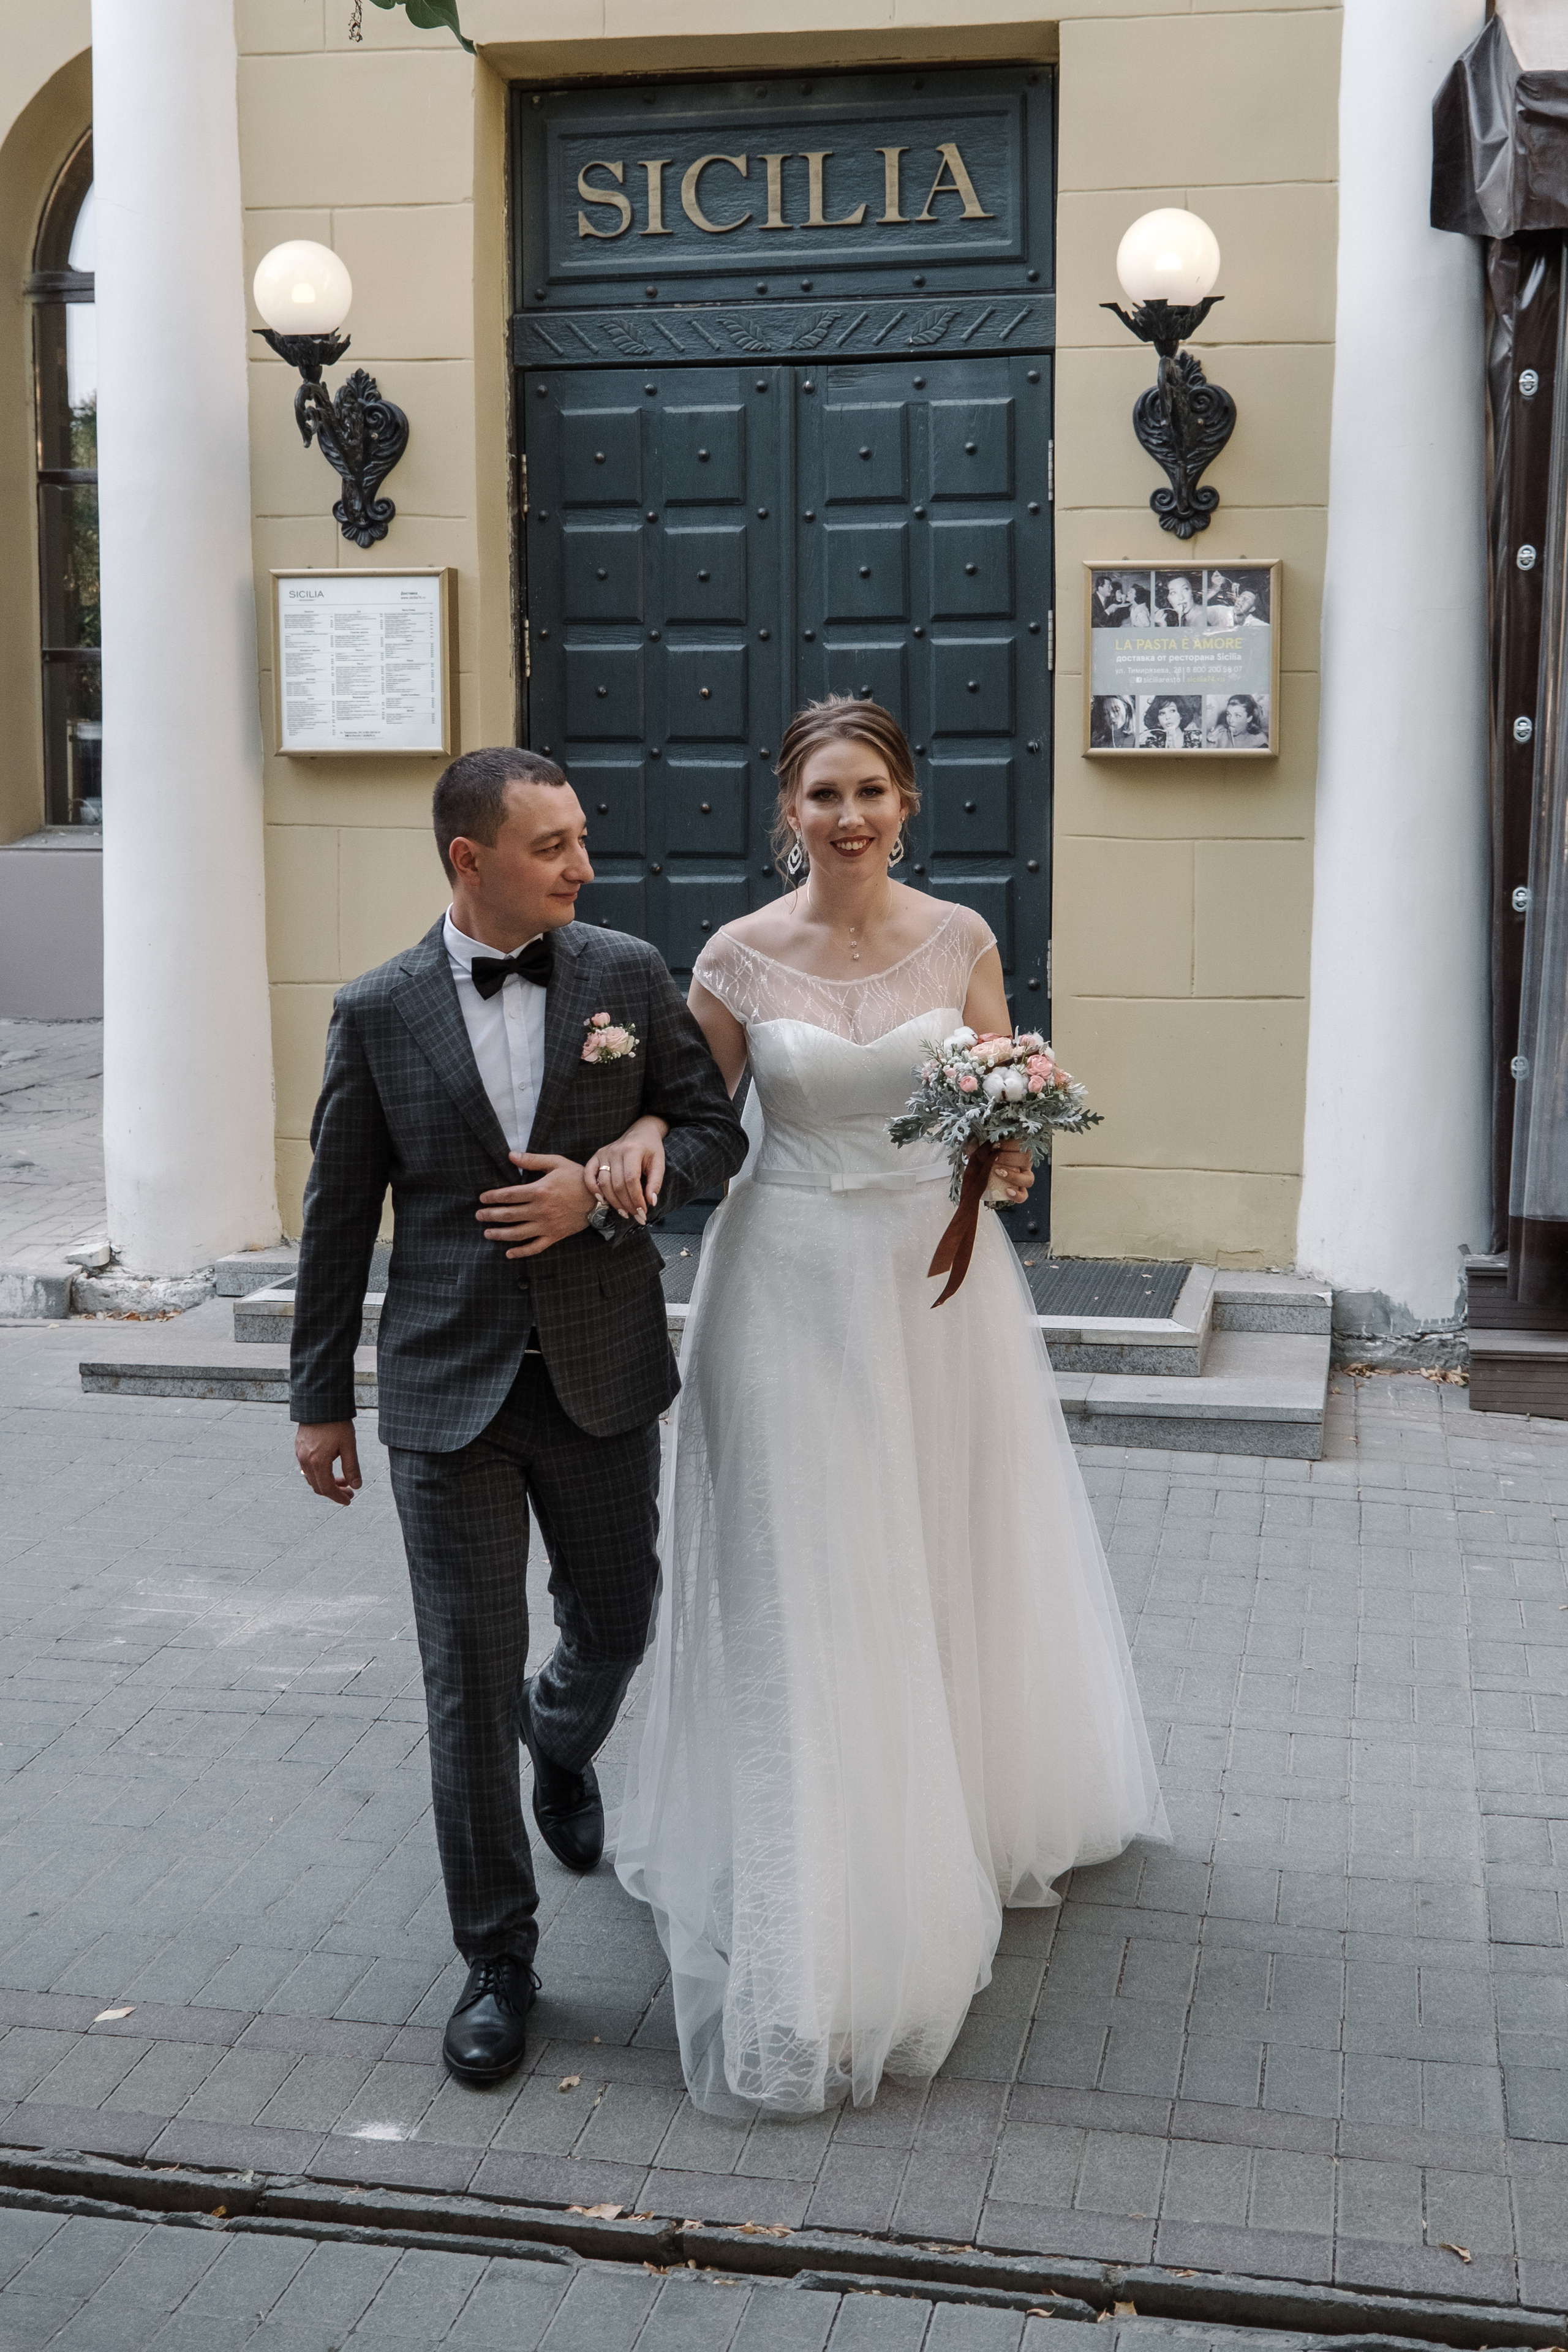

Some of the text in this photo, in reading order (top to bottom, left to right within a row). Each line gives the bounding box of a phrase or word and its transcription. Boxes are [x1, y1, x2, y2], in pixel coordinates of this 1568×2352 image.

[576, 142, 995, 238] SICILIA
[1115, 635, 1243, 650] LA PASTA È AMORE
[1169, 654, 1215, 663] ресторана
[1216, 652, 1242, 661] Sicilia
